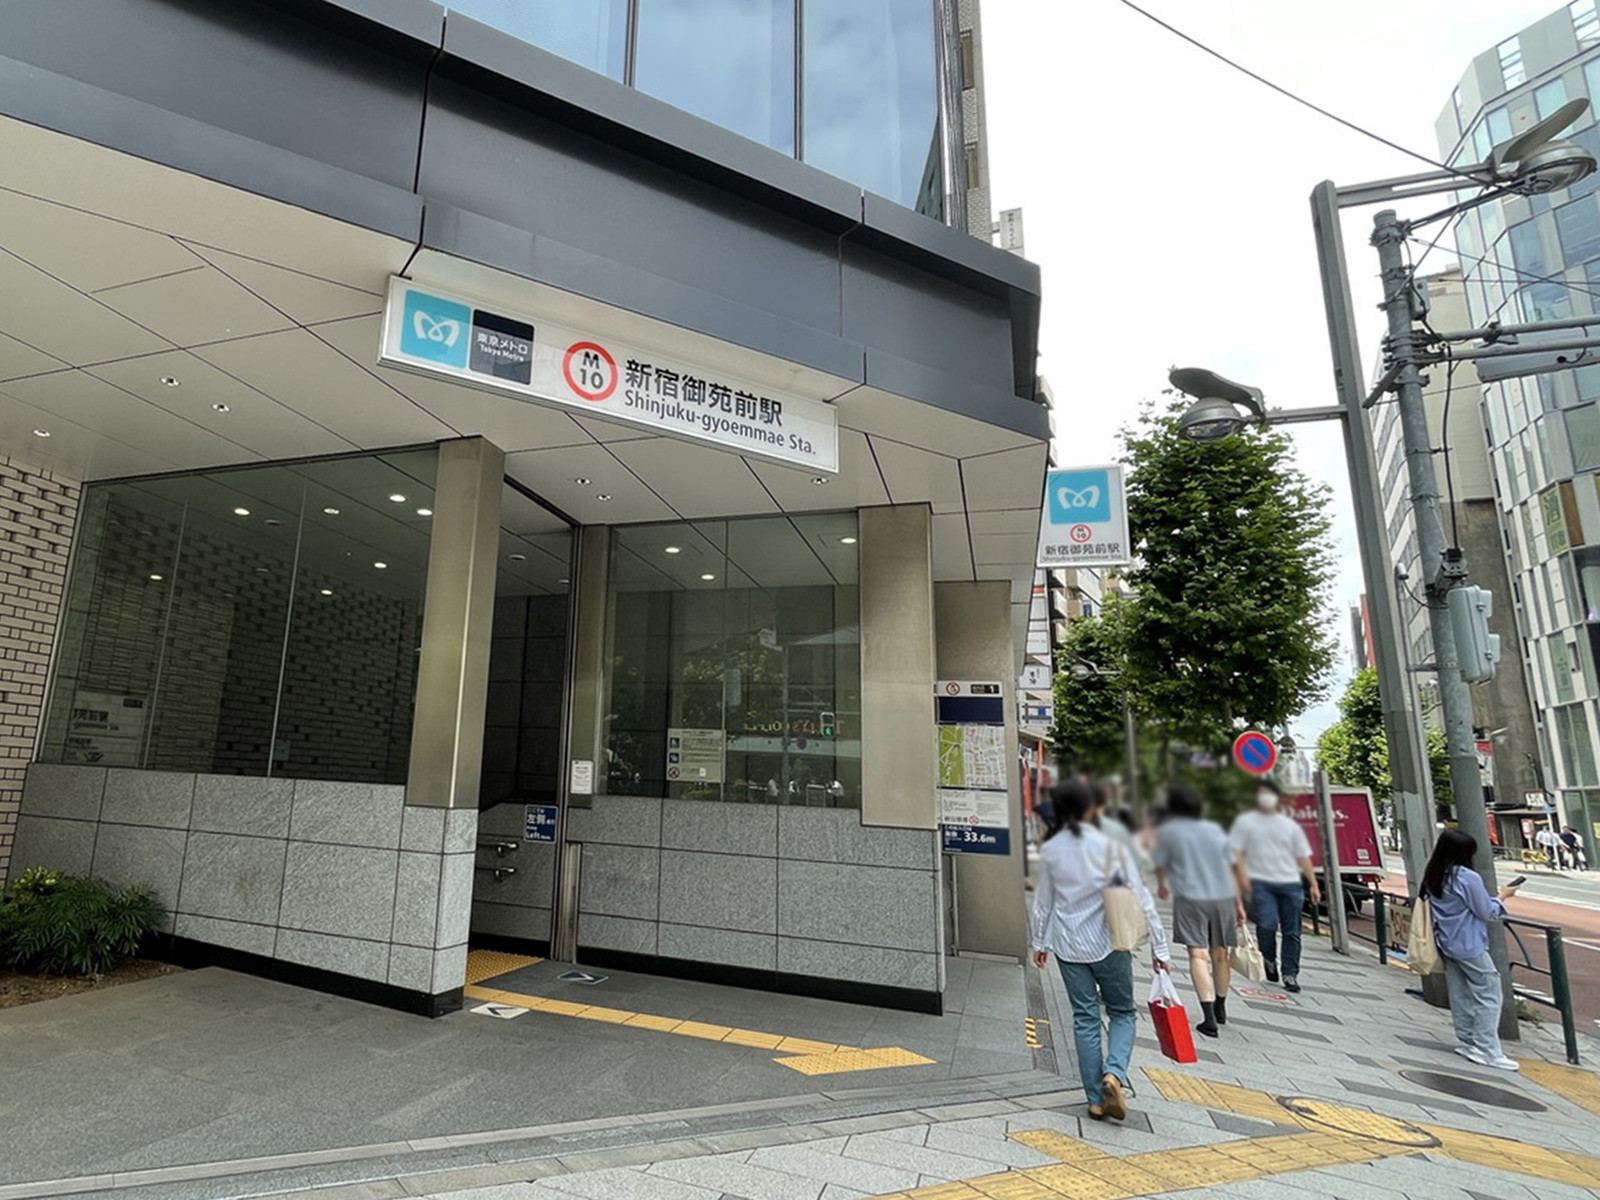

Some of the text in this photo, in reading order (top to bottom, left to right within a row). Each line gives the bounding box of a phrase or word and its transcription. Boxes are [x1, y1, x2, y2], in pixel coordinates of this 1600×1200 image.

[478, 332, 528, 355] 東京メトロ
[480, 344, 524, 362] Tokyo Metro
[582, 351, 600, 370] M
[580, 368, 604, 390] 10
[625, 358, 783, 427] 新宿御苑前駅
[624, 389, 816, 455] Shinjuku-gyoemmae Sta.
[1045, 543, 1120, 555] 新宿御苑前駅
[990, 685, 994, 693] 1
[964, 832, 996, 844] 33.6m
